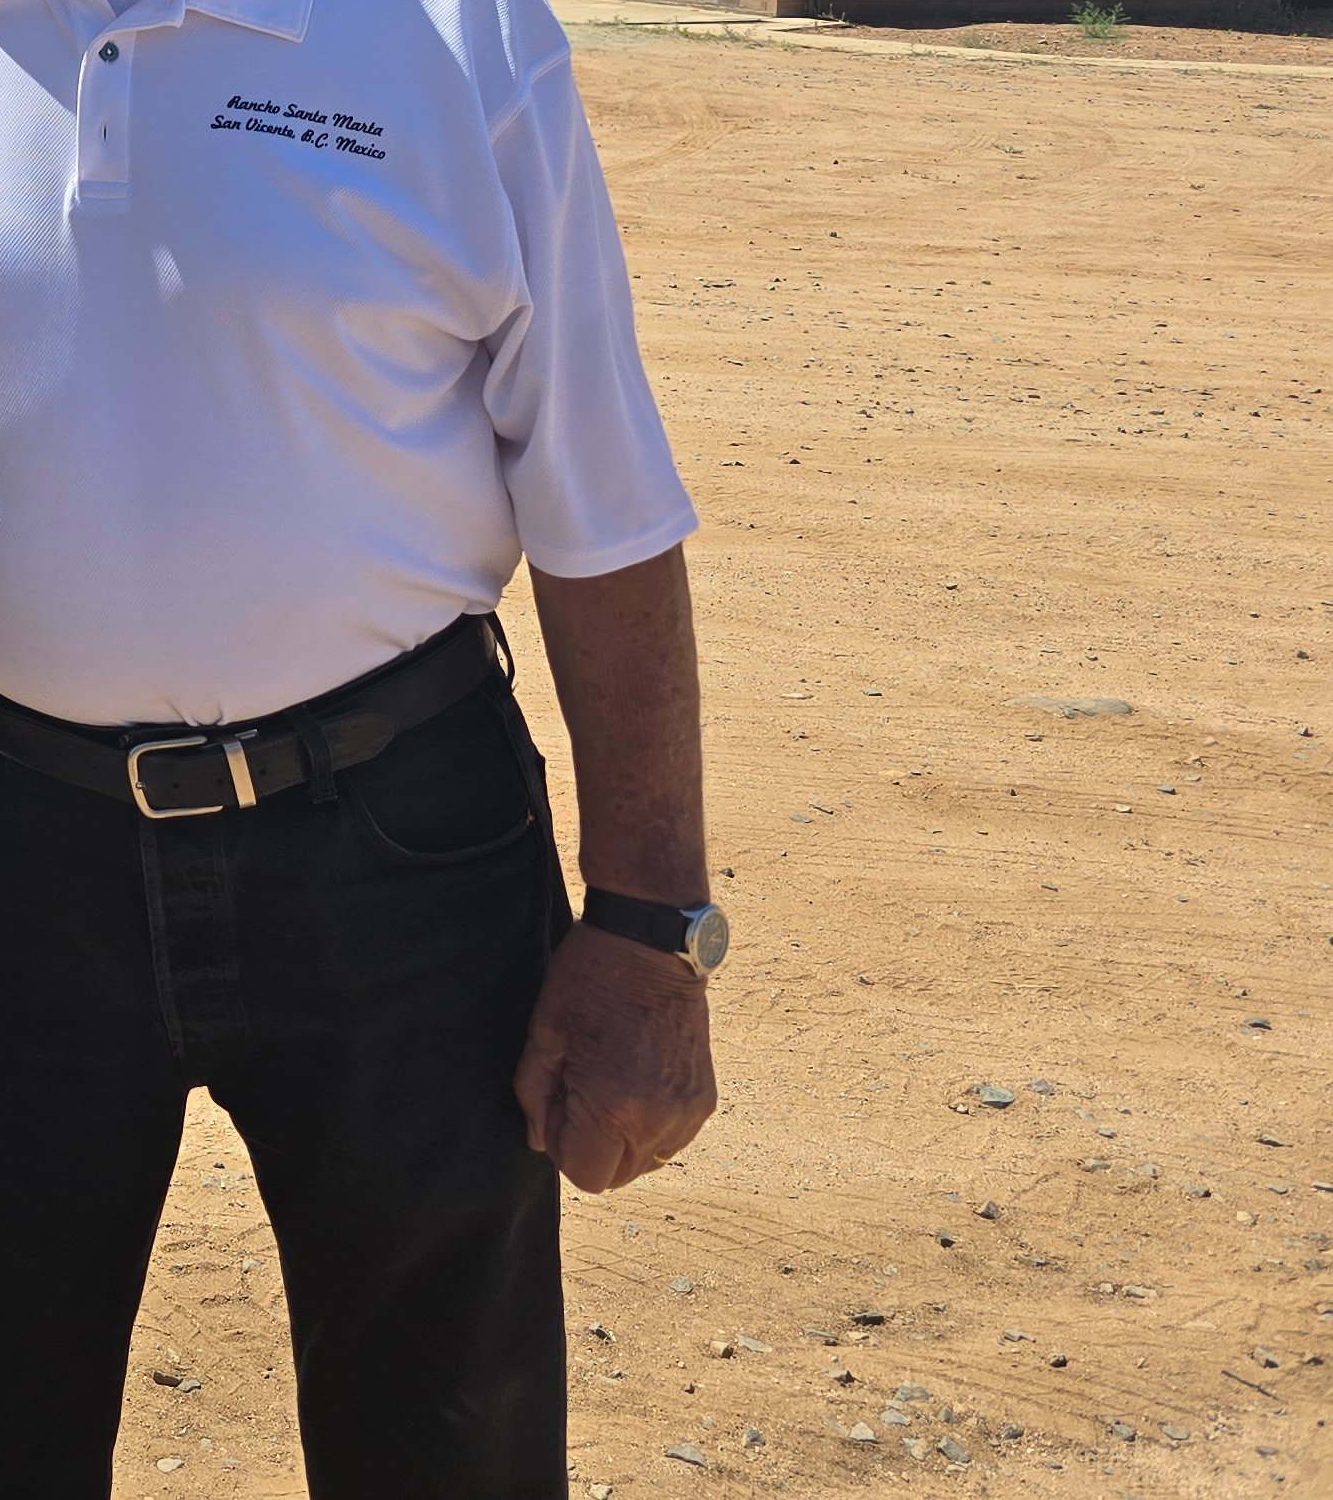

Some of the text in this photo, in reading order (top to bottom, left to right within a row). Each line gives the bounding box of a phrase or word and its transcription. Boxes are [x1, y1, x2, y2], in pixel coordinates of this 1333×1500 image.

[210, 115, 241, 130] San
[336, 136, 386, 160] Mexico
[227, 95, 384, 137] Rancho Santa Marta
